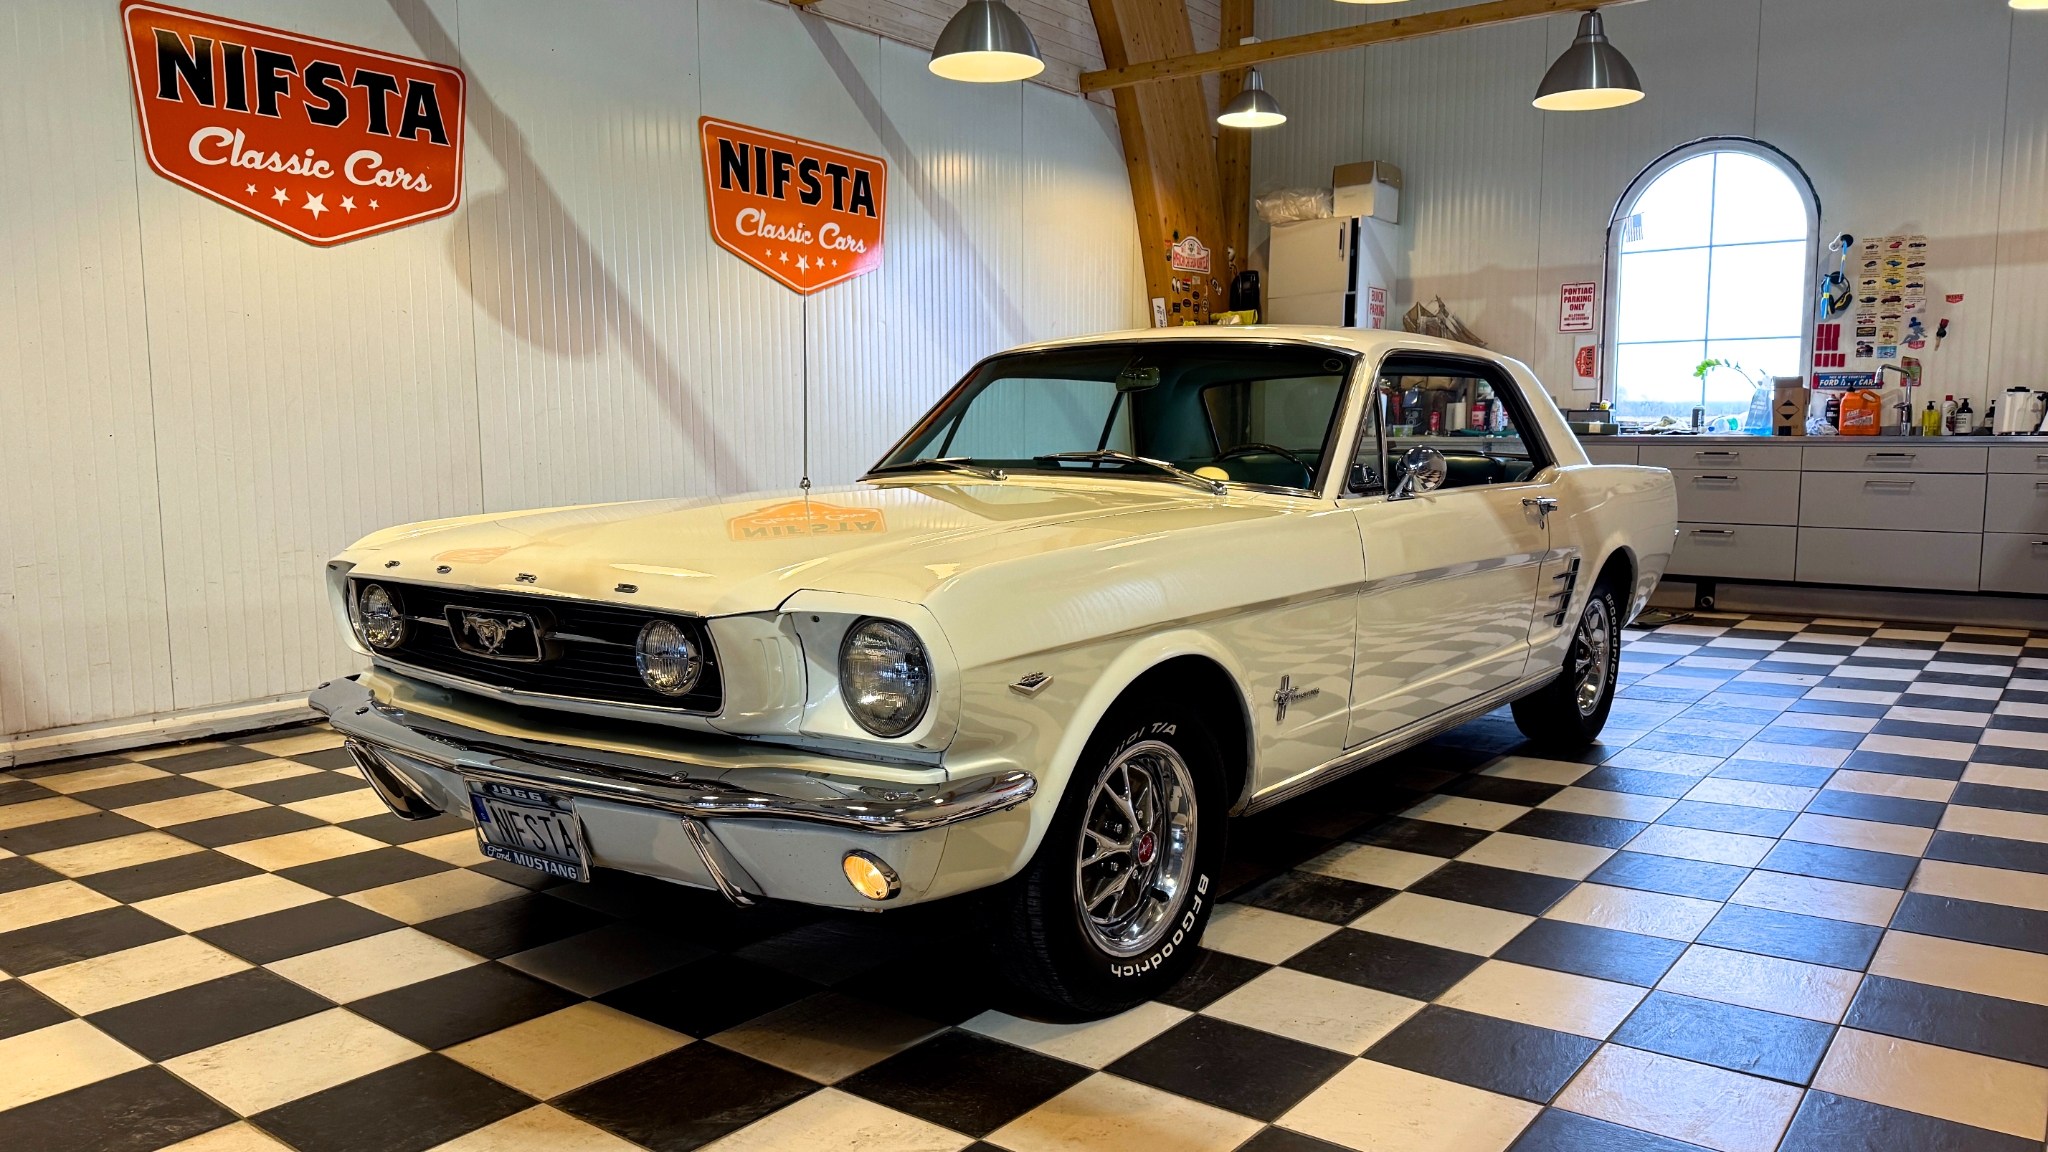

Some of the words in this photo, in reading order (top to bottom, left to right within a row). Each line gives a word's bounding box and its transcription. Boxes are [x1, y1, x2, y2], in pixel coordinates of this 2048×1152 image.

[151, 27, 451, 147] NIFSTA
[188, 126, 335, 179] Classic
[344, 150, 432, 193] Cars
[717, 136, 878, 219] NIFSTA
[735, 207, 814, 245] Classic
[818, 222, 867, 254] Cars
[1563, 287, 1593, 296] PONTIAC
[1563, 295, 1592, 304] PARKING
[1569, 303, 1585, 311] ONLY
[1819, 379, 1839, 387] FORD
[384, 560, 639, 594] FORD
[1605, 593, 1619, 685] BFGoodrich
[1150, 722, 1177, 735] T/A
[491, 784, 543, 801] 1966
[489, 805, 581, 859] NIFSTA
[486, 845, 512, 862] Ford
[513, 851, 578, 880] MUSTANG
[1110, 873, 1210, 978] BFGoodrich
